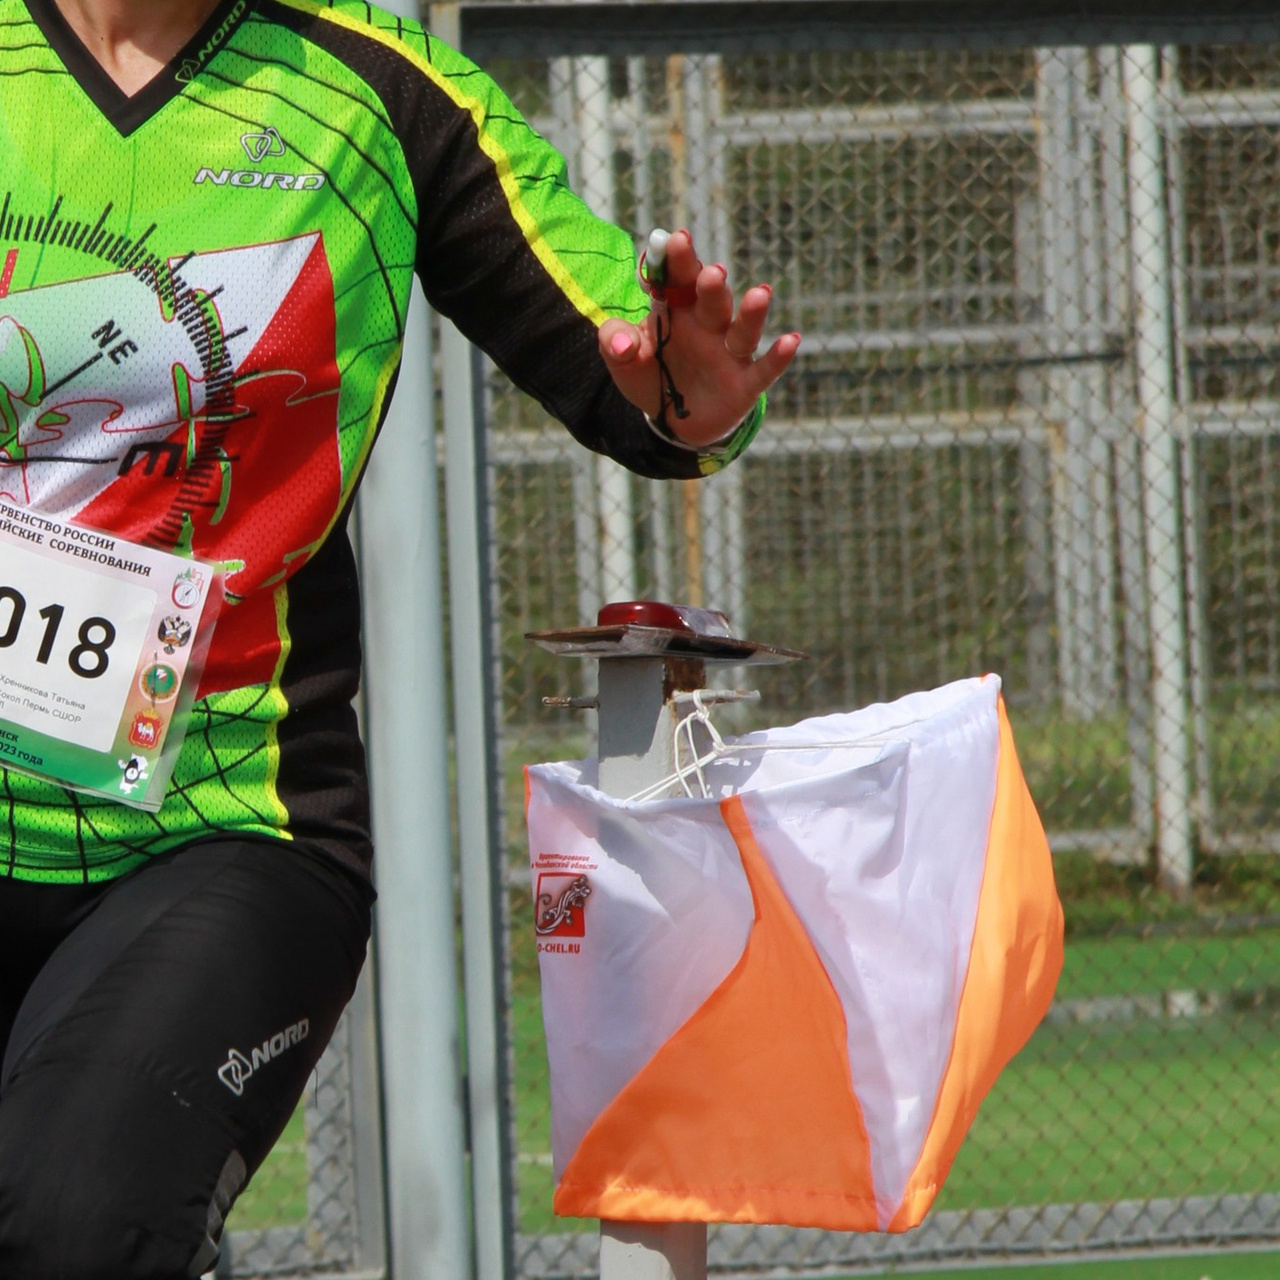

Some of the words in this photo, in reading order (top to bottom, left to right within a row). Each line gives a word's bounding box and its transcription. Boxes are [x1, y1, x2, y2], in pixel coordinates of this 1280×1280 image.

[198, 0, 246, 62] NORD
[193, 167, 327, 191] NORD
[90, 320, 138, 366] NE
[49, 538, 152, 577] СОРЕВНОВАНИЯ
[63, 526, 116, 552] РОССИИ
[0, 674, 48, 699] Хренникова
[51, 692, 86, 711] Татьяна
[22, 698, 50, 715] Пермь
[18, 750, 44, 767] года
[251, 1018, 309, 1070] NORD
